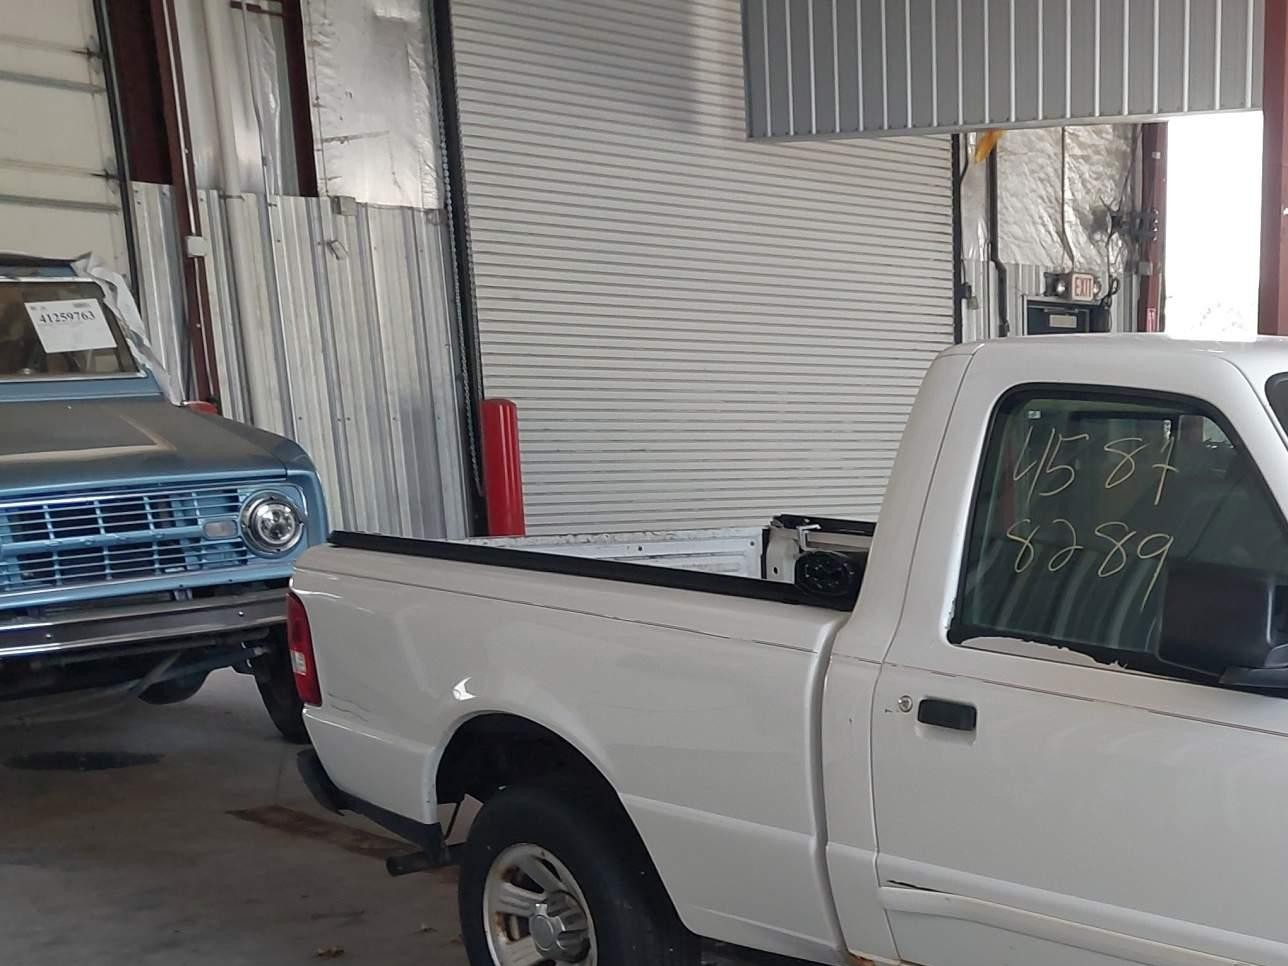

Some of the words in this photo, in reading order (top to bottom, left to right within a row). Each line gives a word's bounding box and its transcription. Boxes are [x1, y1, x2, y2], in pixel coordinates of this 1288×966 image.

[1075, 276, 1092, 298] EXIT
[39, 310, 97, 324] 41259763
[1007, 518, 1175, 611] 8289
